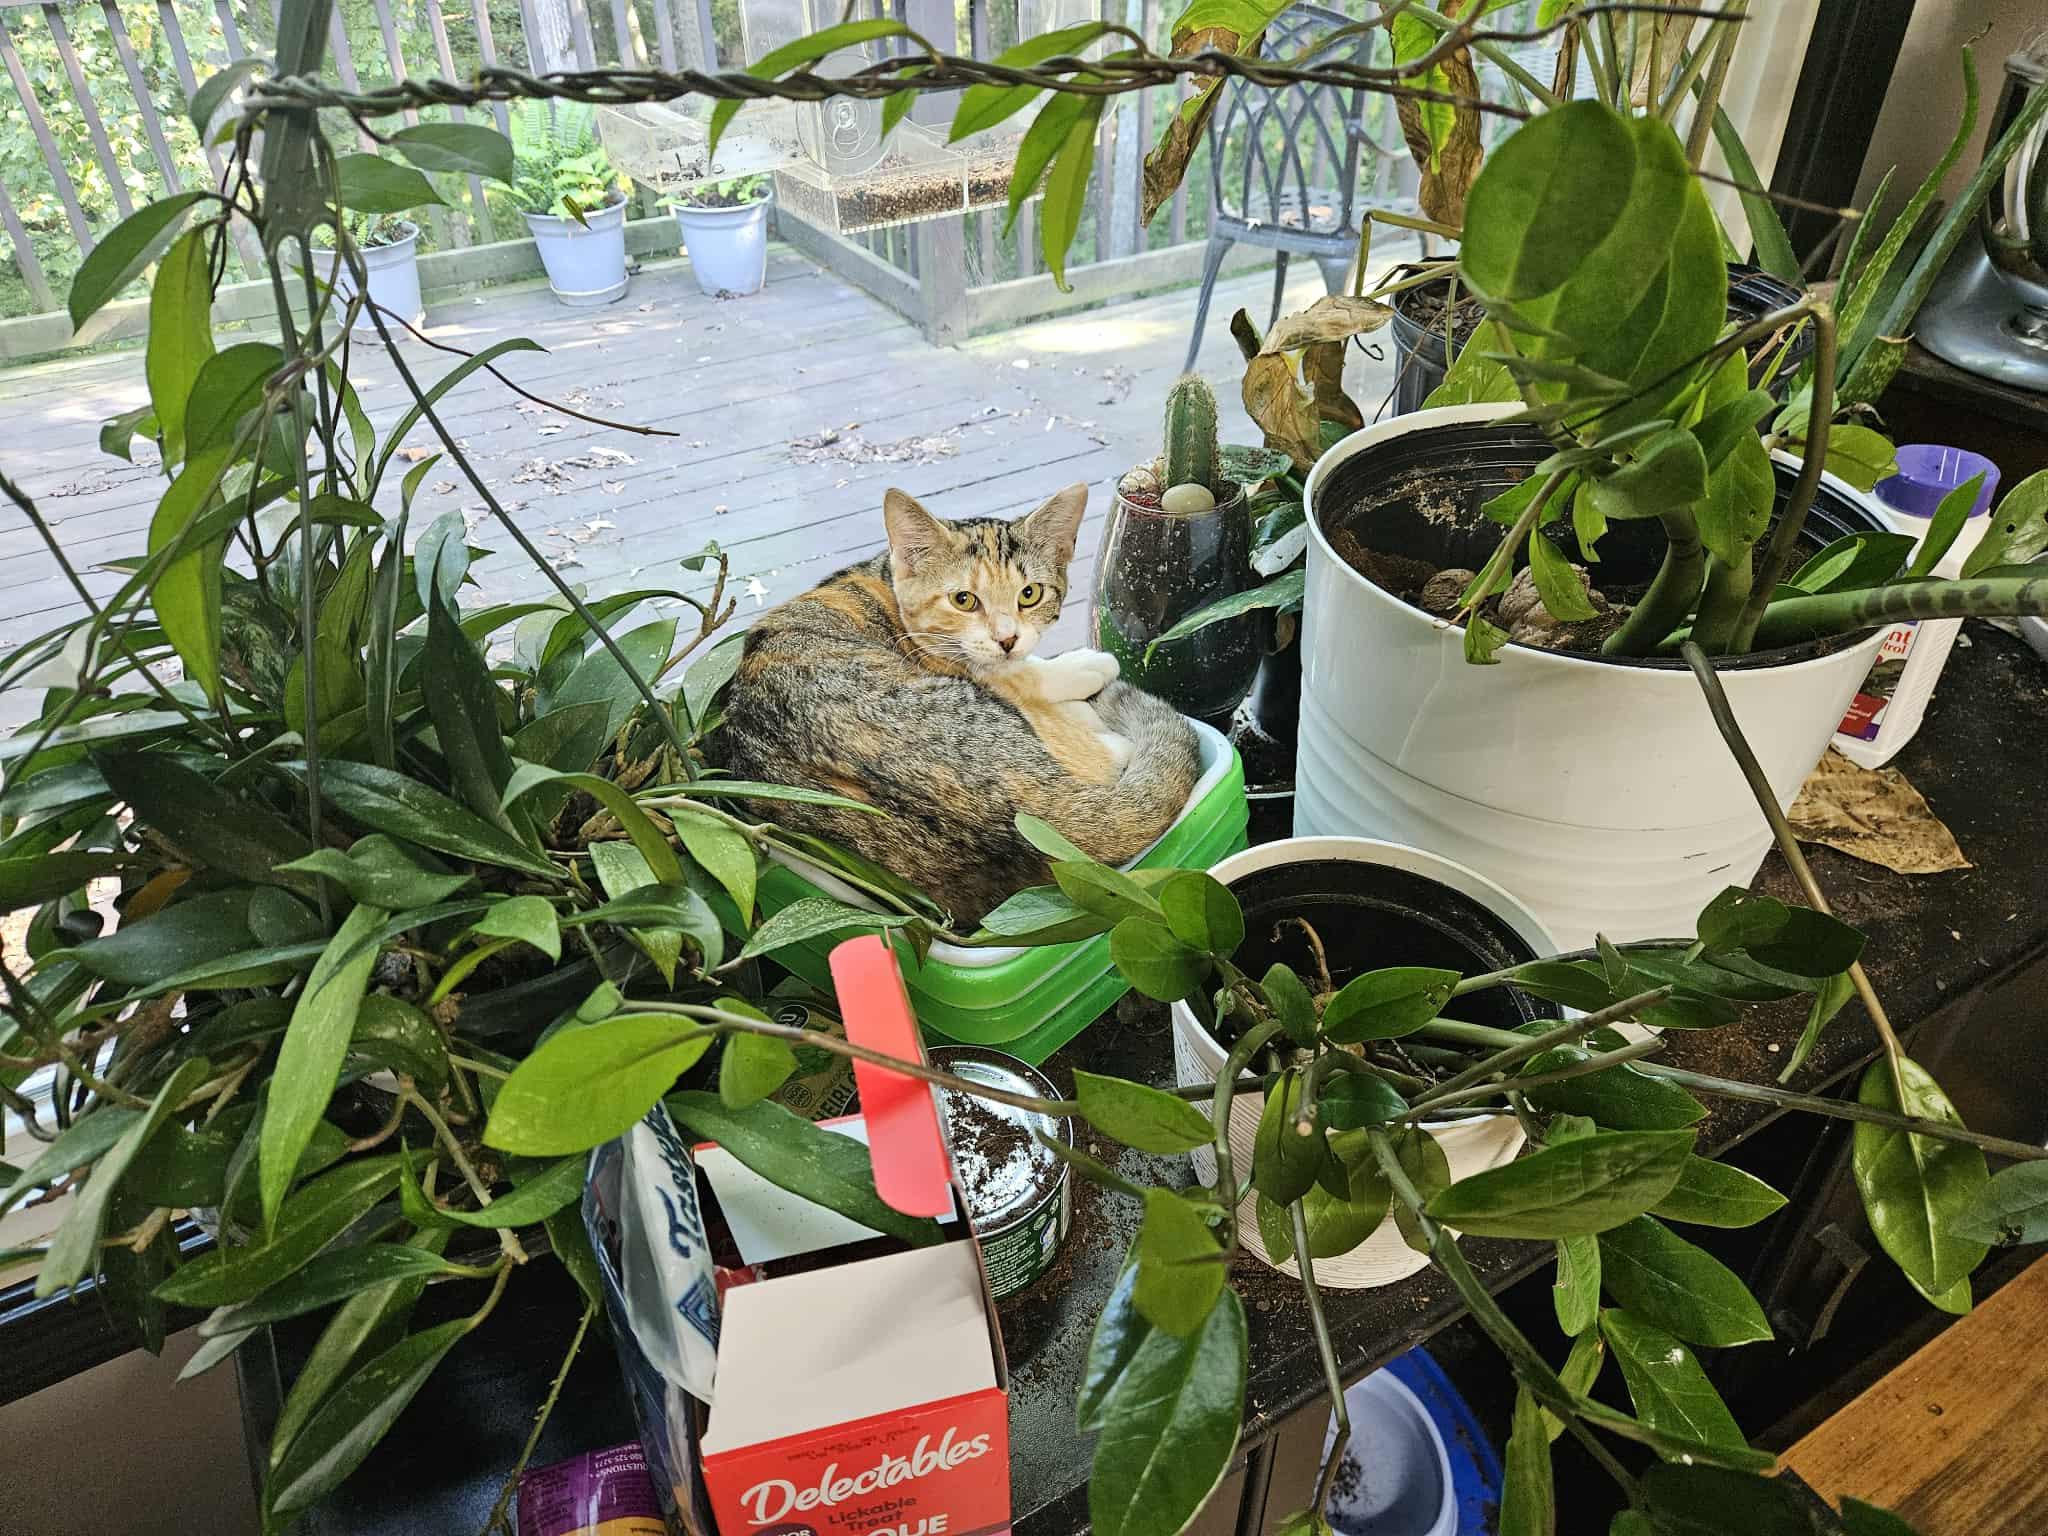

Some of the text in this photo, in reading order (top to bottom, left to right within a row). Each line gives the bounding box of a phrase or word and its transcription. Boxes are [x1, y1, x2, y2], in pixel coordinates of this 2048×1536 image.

[741, 1426, 991, 1525] Delectables
[828, 1496, 917, 1525] Lickable
[845, 1511, 903, 1532] Treat
